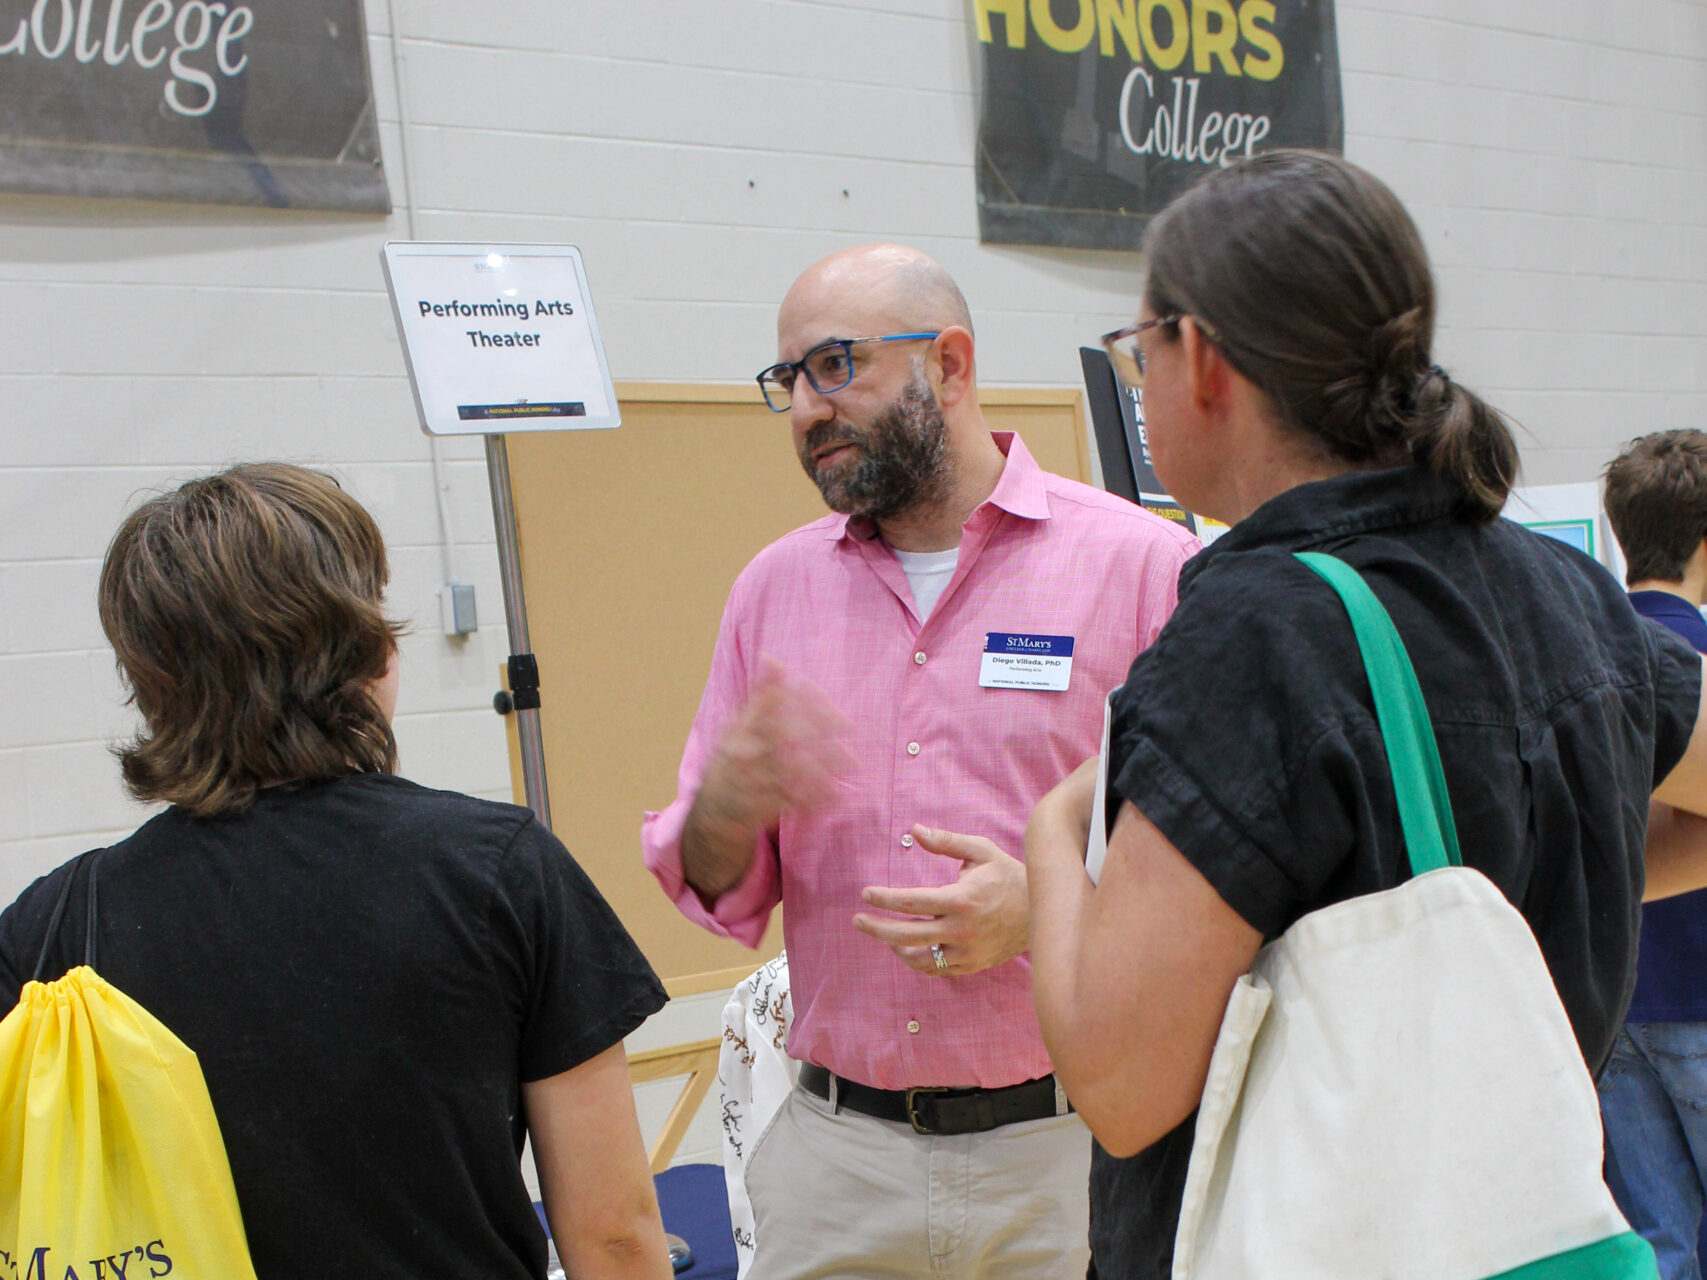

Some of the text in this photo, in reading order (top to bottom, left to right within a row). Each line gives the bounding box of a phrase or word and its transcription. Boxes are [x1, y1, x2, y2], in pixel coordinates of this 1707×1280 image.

[0, 0, 254, 116] ollege
[973, 0, 1284, 81] HONORS
[1119, 67, 1270, 168] College
[418, 299, 574, 320] Performing Arts
[466, 331, 541, 347] Theater
[992, 657, 1014, 665] Diego
[1016, 658, 1043, 667] Villada,
